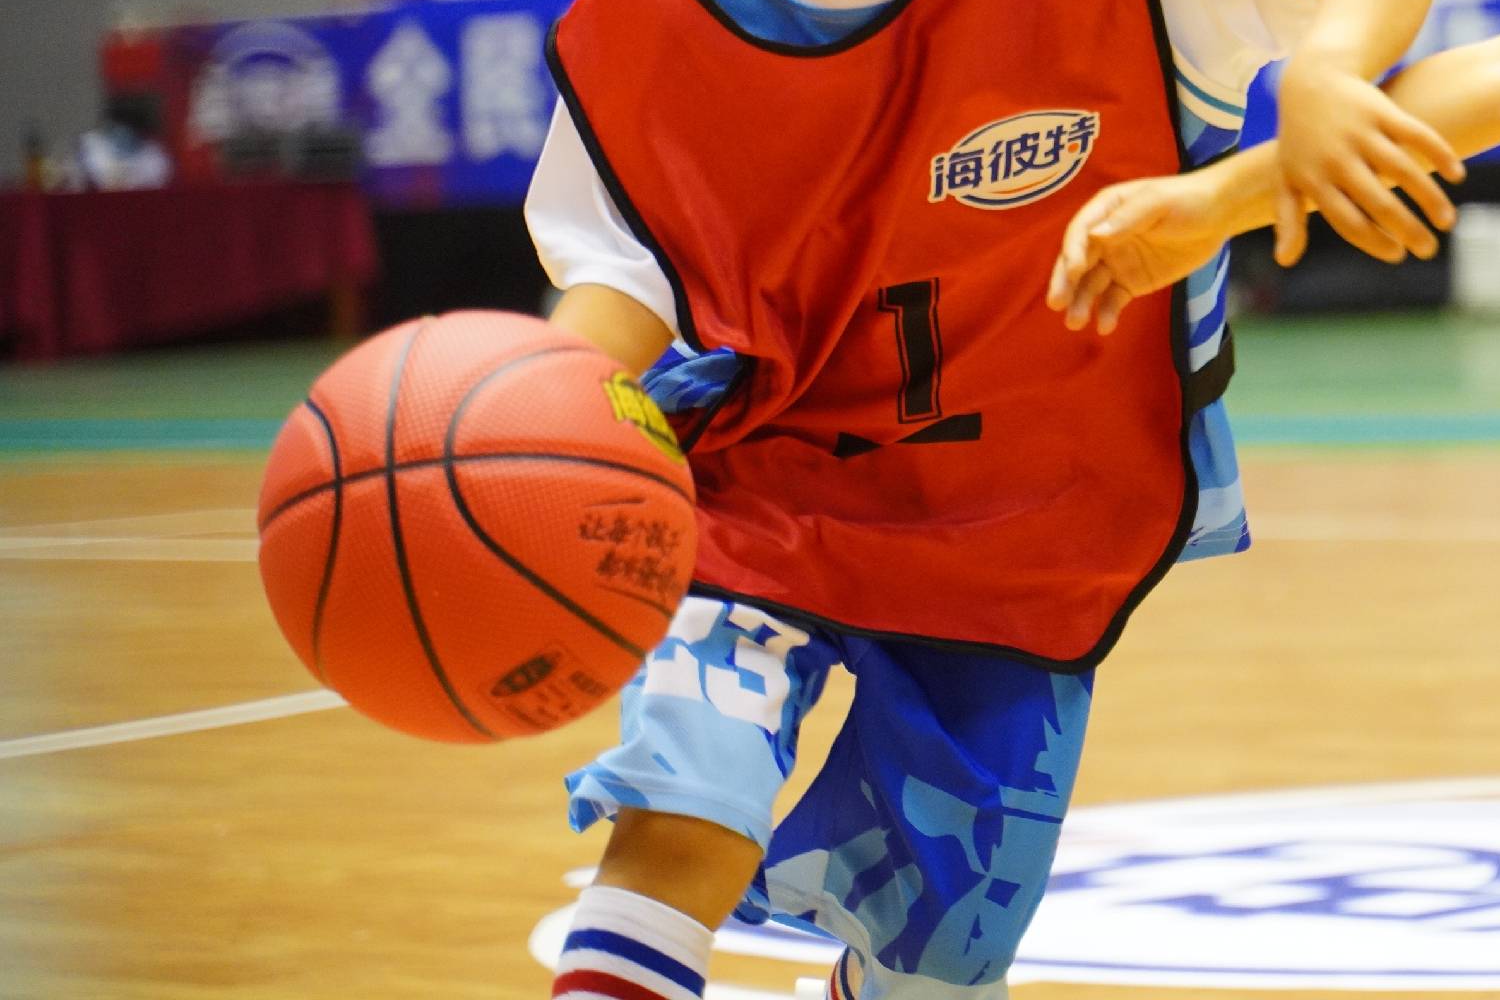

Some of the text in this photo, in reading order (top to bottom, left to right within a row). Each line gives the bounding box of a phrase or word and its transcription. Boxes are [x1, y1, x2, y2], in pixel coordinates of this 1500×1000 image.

[932, 114, 1098, 199] 海彼特
[877, 277, 942, 424] 1
